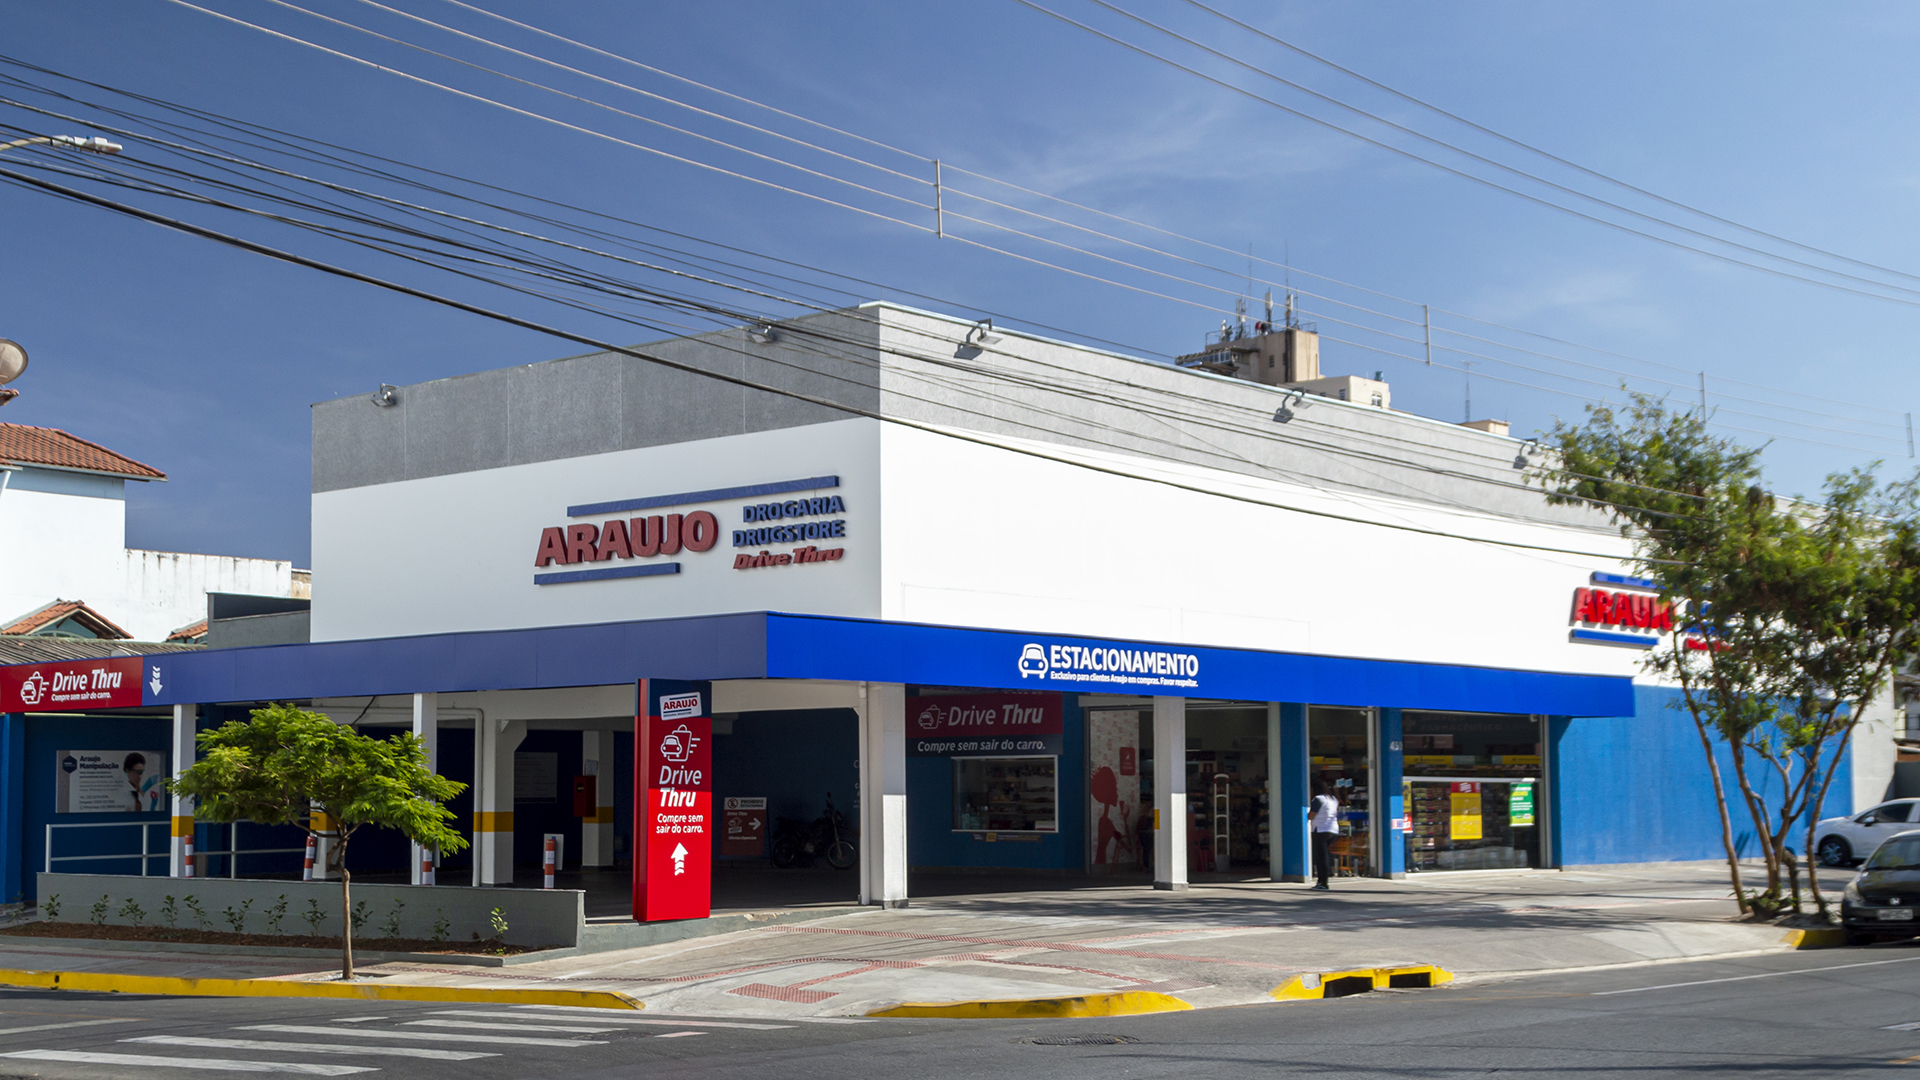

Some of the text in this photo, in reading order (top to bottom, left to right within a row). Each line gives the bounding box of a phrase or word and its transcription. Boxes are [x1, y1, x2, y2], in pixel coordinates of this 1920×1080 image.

[743, 495, 846, 523] DROGARIA
[534, 510, 719, 567] ARAUJO
[732, 520, 846, 547] DRUGSTORE
[733, 545, 844, 569] Drive Thru
[1050, 645, 1199, 677] ESTACIONAMENTO
[52, 668, 122, 692] Drive Thru
[1050, 670, 1199, 688] Exclusivo para clientes Araujo em compras. Favor respeitar.
[51, 693, 70, 702] Compre
[80, 691, 90, 700] sair
[663, 698, 698, 710] ARAUJO
[947, 703, 1044, 726] Drive Thru
[917, 739, 1046, 753] Compre sem sair do carro.
[80, 755, 101, 763] Araujo
[80, 762, 119, 770] Manipulação
[659, 765, 702, 785] Drive
[660, 787, 696, 807] Thru
[657, 813, 704, 824] Compre sem
[656, 824, 704, 834] sair do carro.
